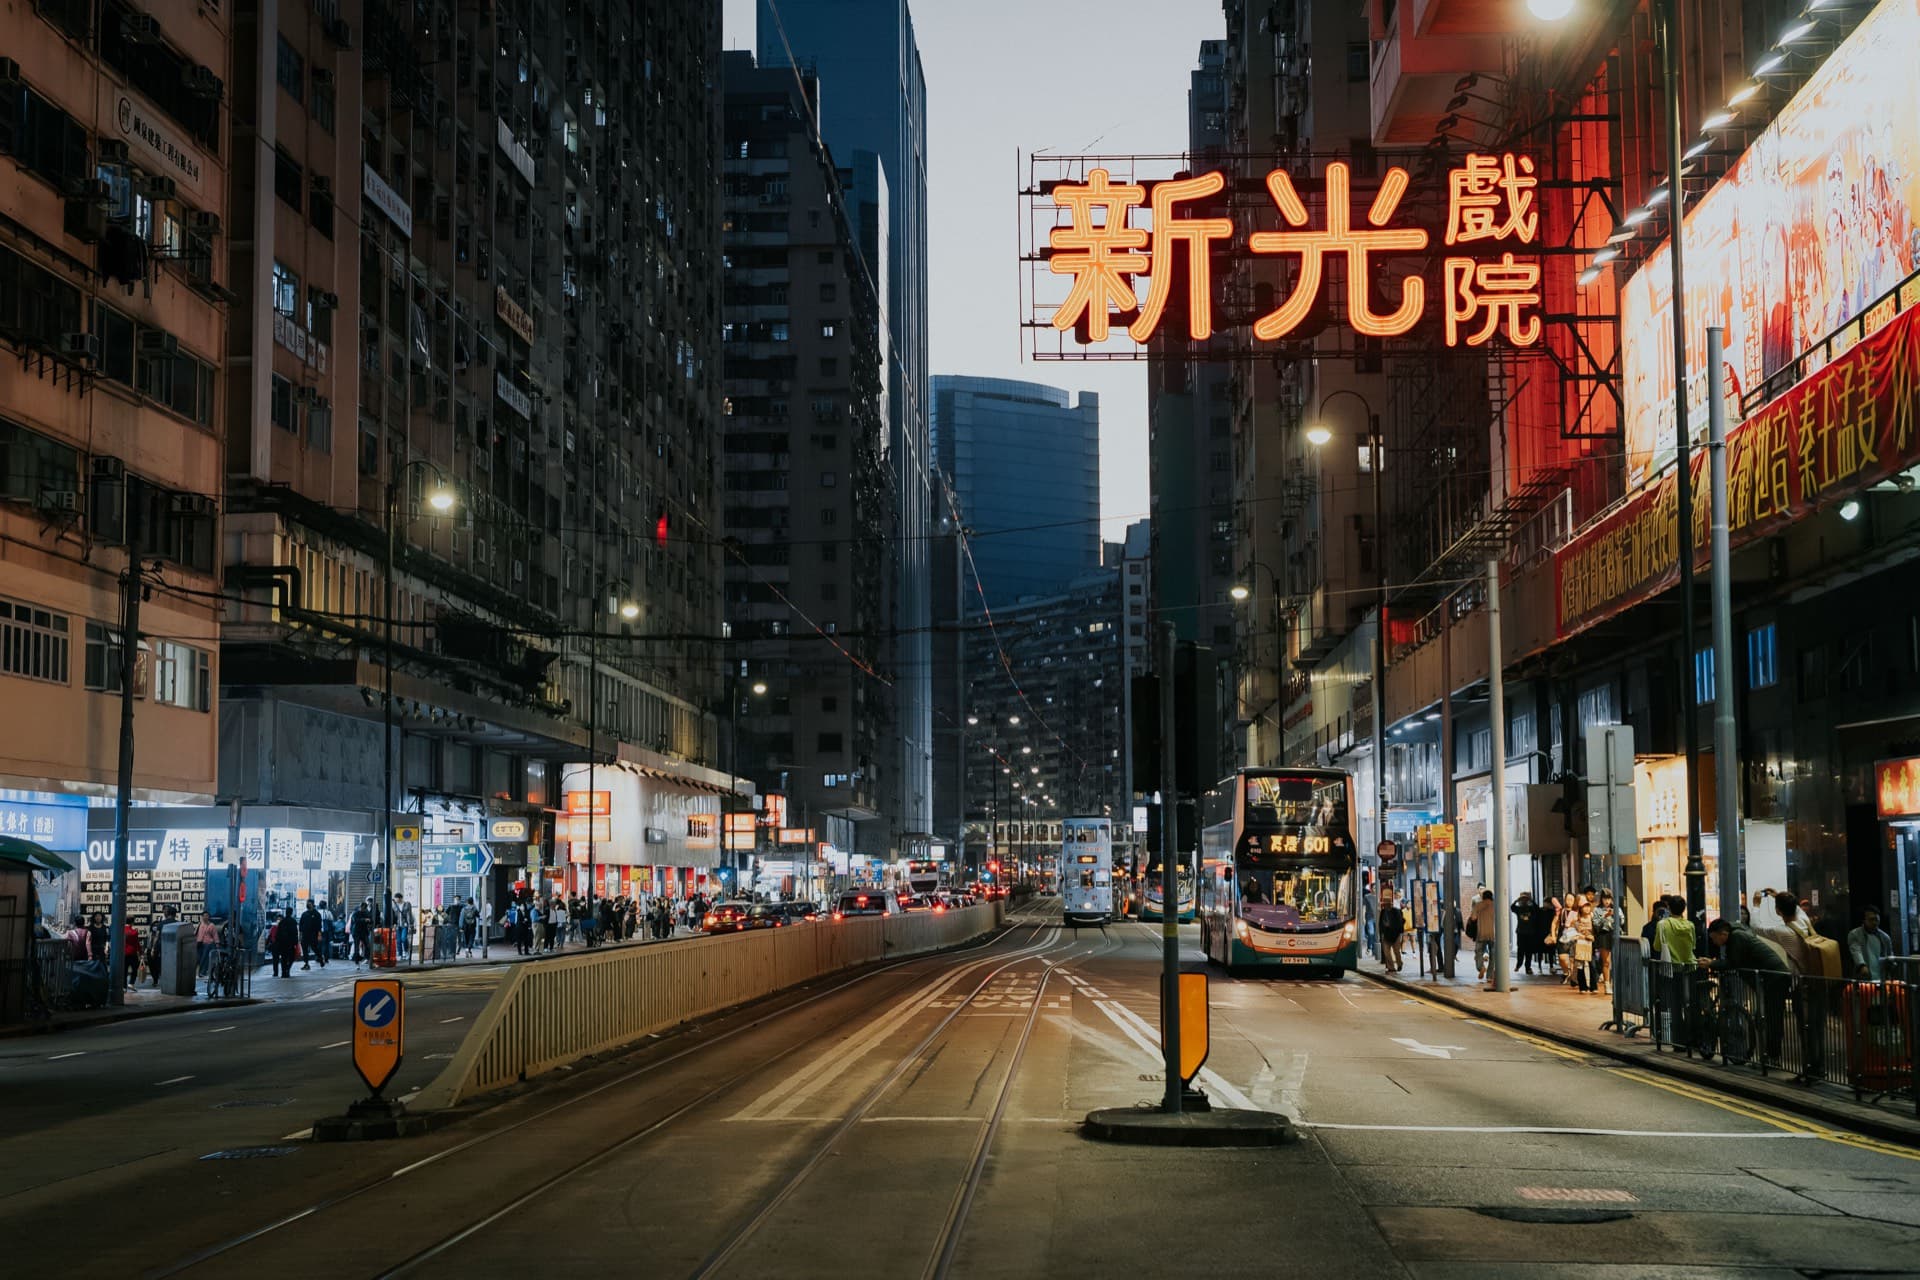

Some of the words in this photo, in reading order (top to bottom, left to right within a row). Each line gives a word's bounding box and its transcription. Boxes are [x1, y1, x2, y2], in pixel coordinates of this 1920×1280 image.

[1050, 162, 1428, 343] 新光
[1444, 152, 1542, 348] 戲院
[89, 840, 157, 861] OULET
[1304, 836, 1329, 853] 601
